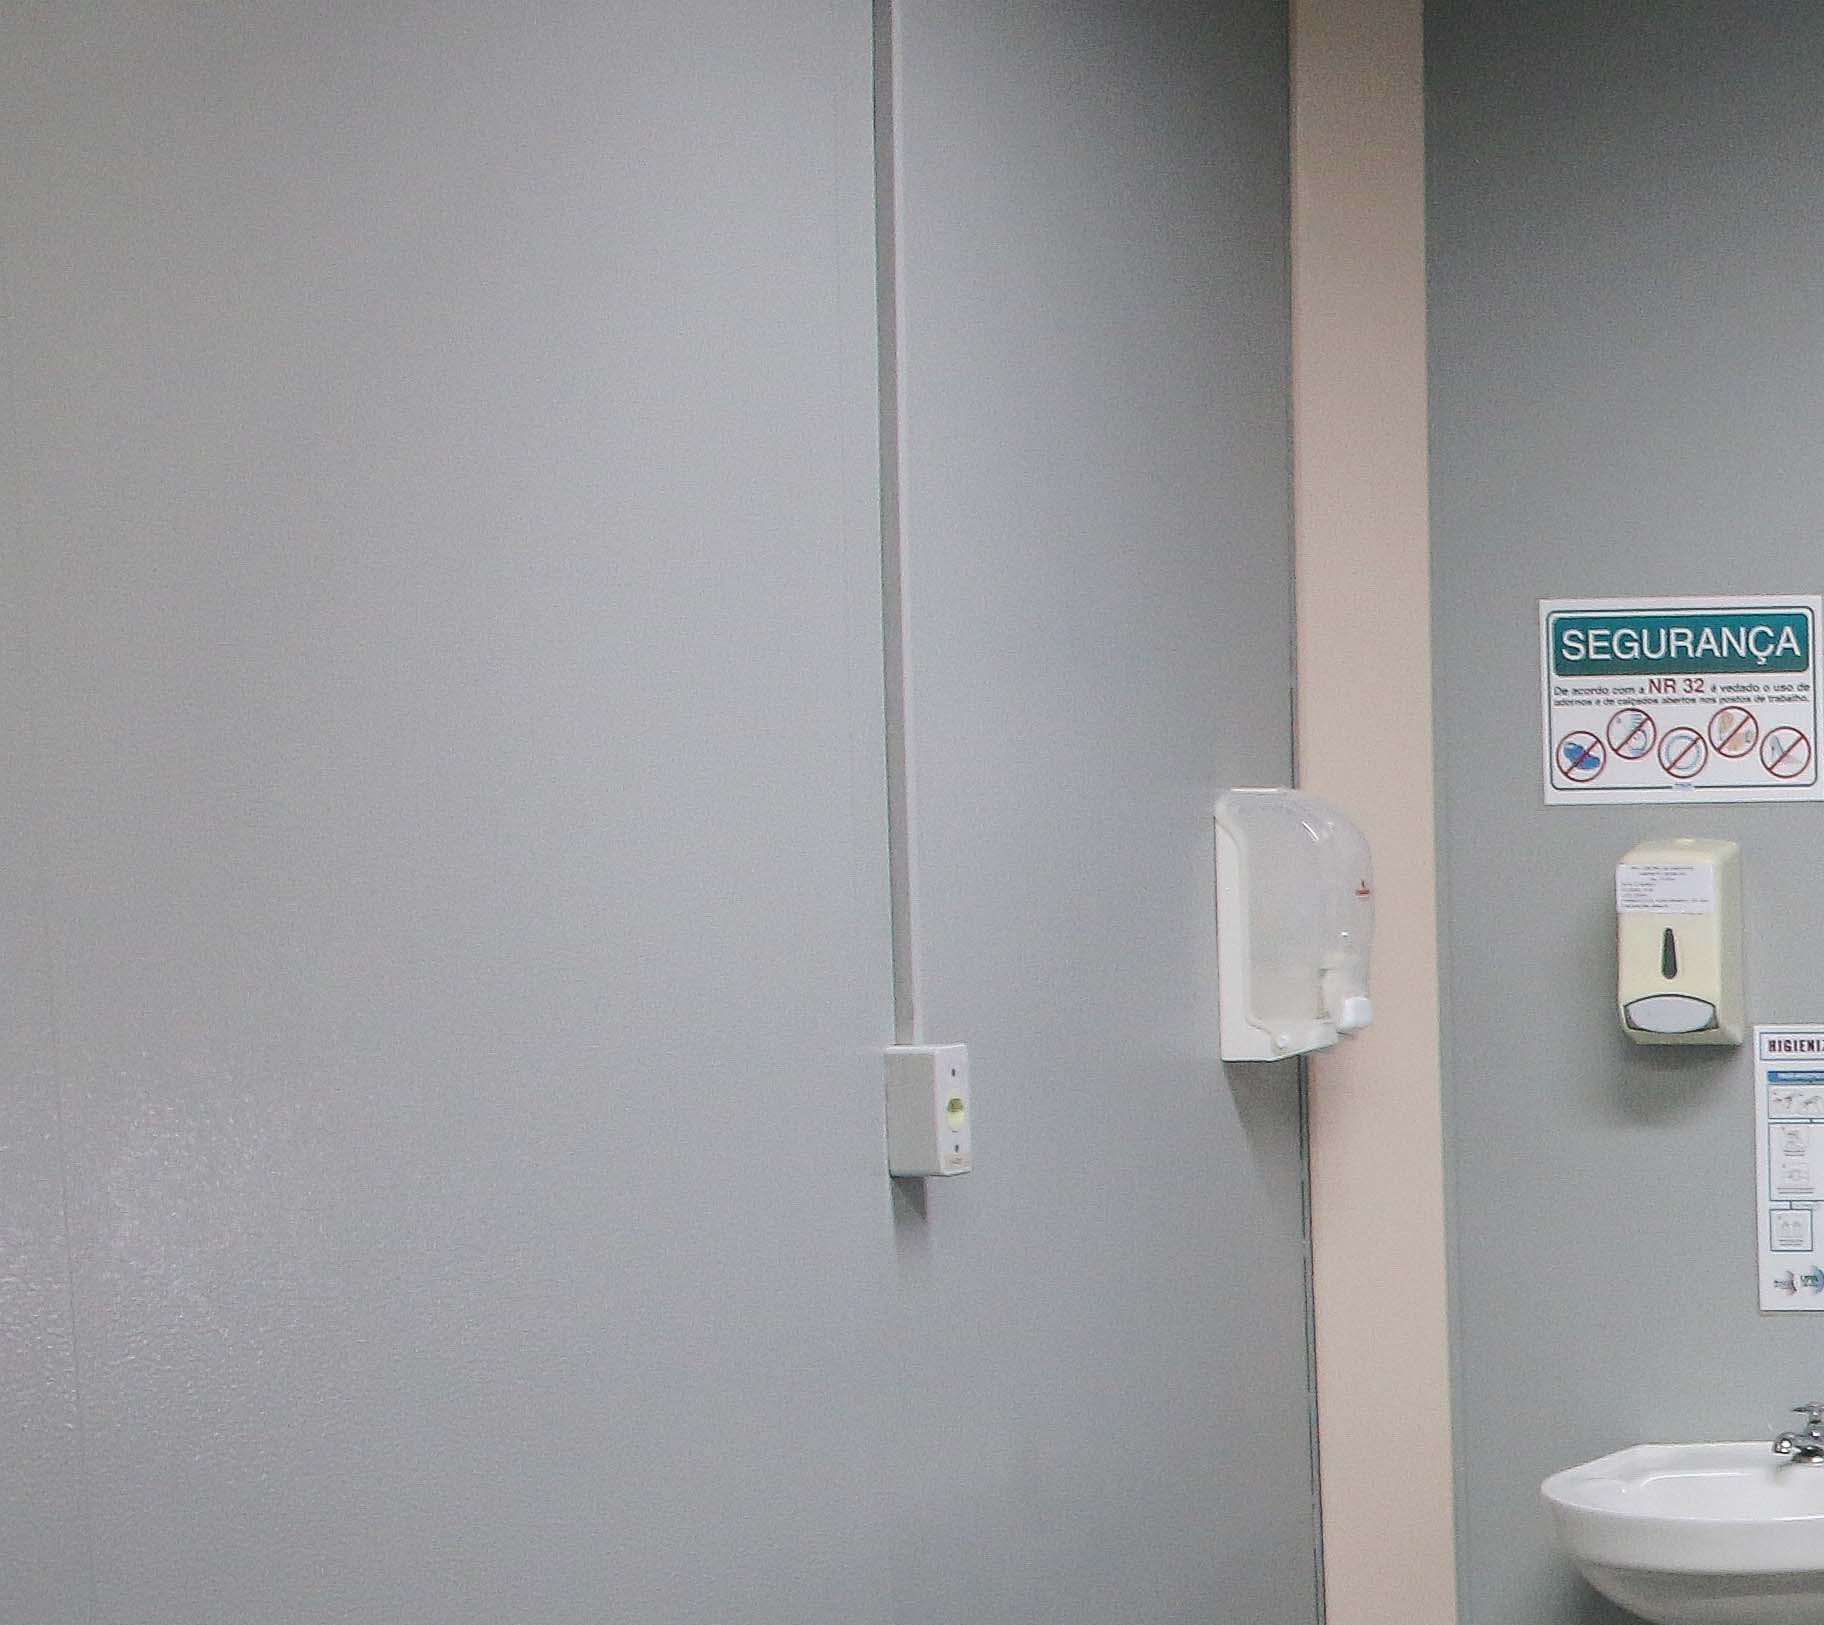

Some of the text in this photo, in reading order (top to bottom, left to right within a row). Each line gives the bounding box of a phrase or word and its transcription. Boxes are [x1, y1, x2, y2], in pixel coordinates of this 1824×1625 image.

[1561, 625, 1801, 664] SEGURANÇA
[1647, 678, 1676, 694] NR
[1682, 677, 1704, 693] 32
